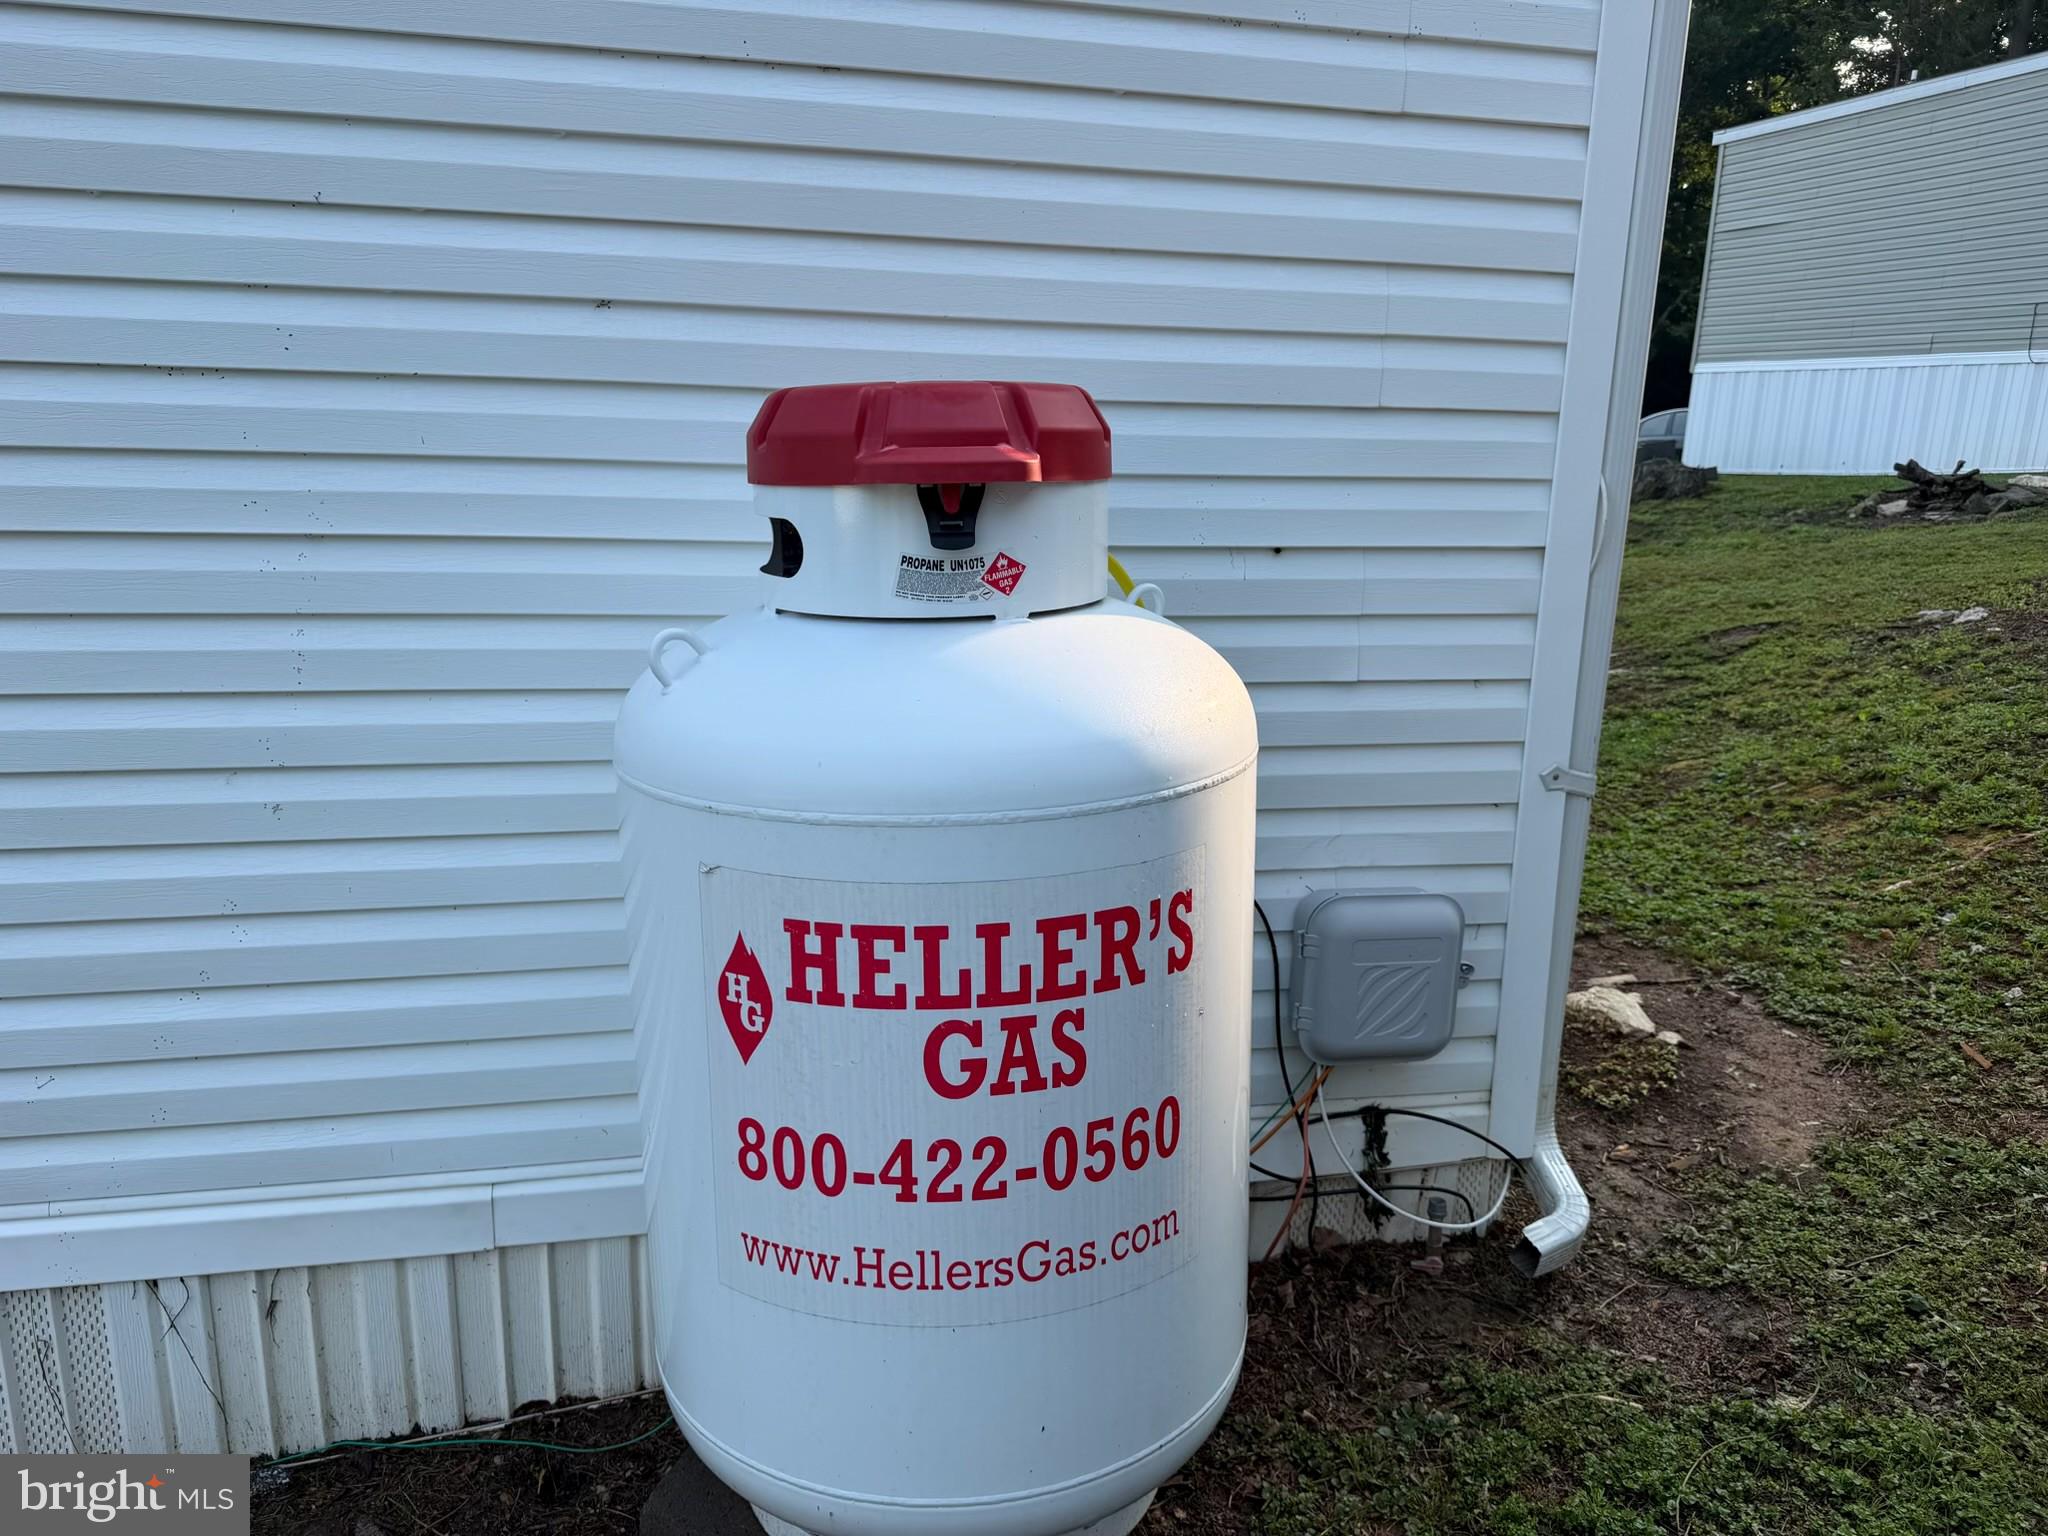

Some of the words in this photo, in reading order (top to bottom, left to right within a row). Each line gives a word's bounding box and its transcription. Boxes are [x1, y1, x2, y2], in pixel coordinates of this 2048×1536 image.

[900, 555, 945, 572] PROPANE
[950, 557, 986, 572] UN1075
[984, 564, 1024, 582] FLAMMABLE
[998, 579, 1013, 587] GAS
[783, 889, 1195, 1010] HELLER'S
[923, 1007, 1088, 1100] GAS
[738, 1096, 1181, 1203] 800-422-0560
[740, 1208, 1180, 1291] www.HellersGas.com
